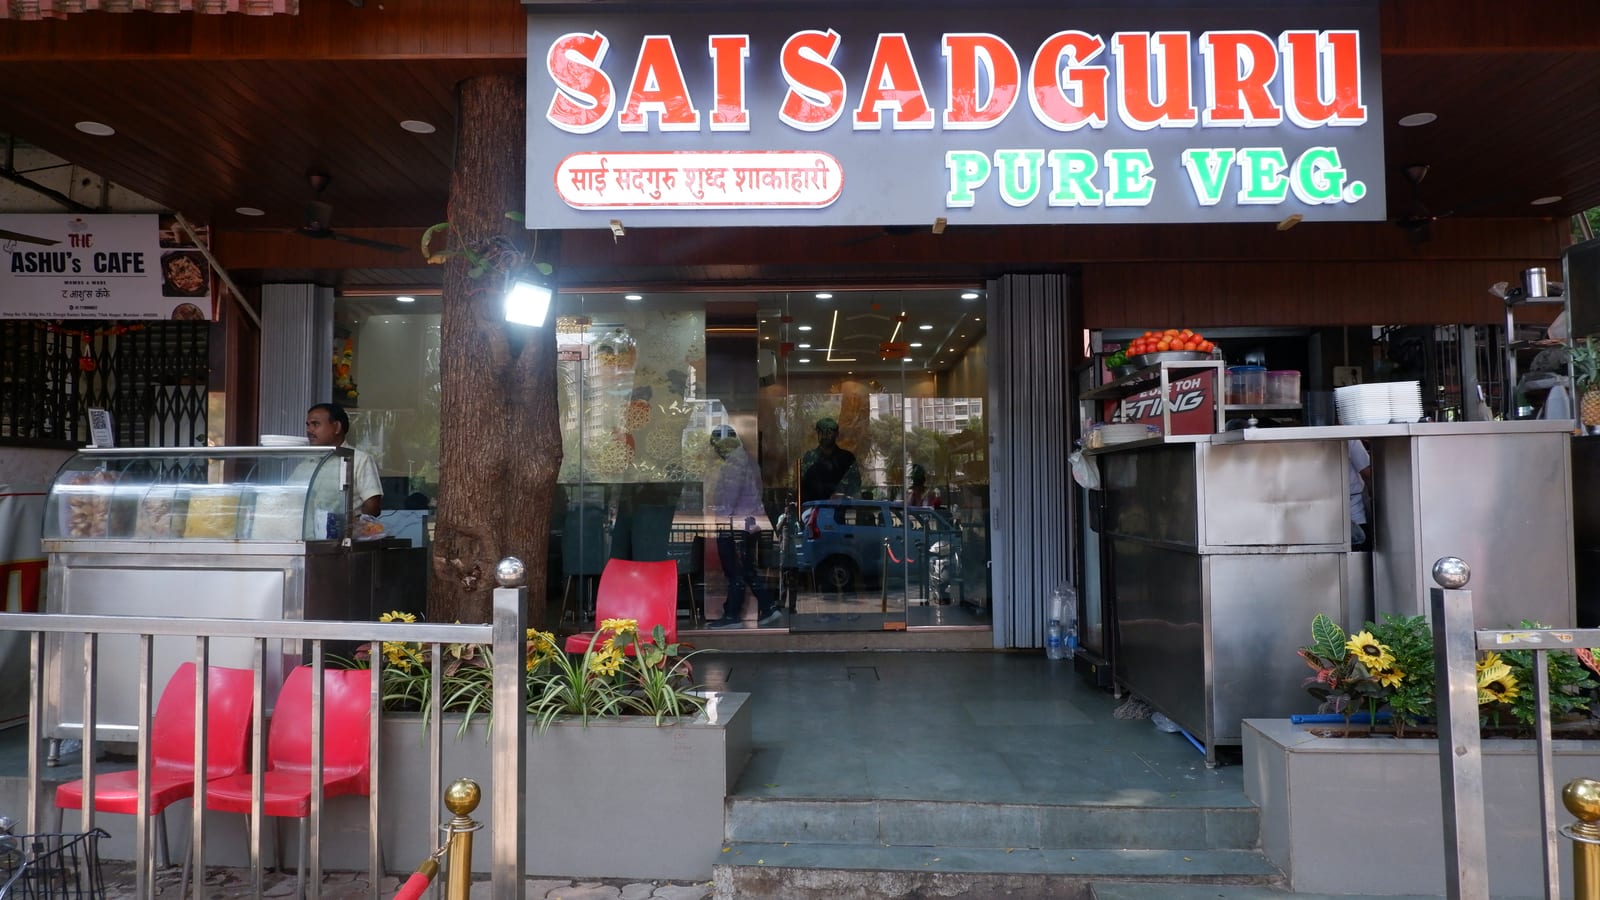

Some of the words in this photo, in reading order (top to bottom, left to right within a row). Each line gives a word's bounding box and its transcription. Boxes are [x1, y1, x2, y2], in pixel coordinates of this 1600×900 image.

[546, 29, 750, 134] SAI
[778, 28, 1368, 132] SADGURU
[568, 157, 609, 194] साई
[613, 167, 678, 200] सदगुरु
[732, 159, 830, 193] शाकाहारी
[945, 148, 1156, 208] PURE
[1181, 146, 1367, 206] VEG.
[68, 233, 94, 248] THE
[11, 251, 82, 273] ASHU's
[93, 252, 145, 273] CAFE
[1176, 377, 1201, 392] TOH
